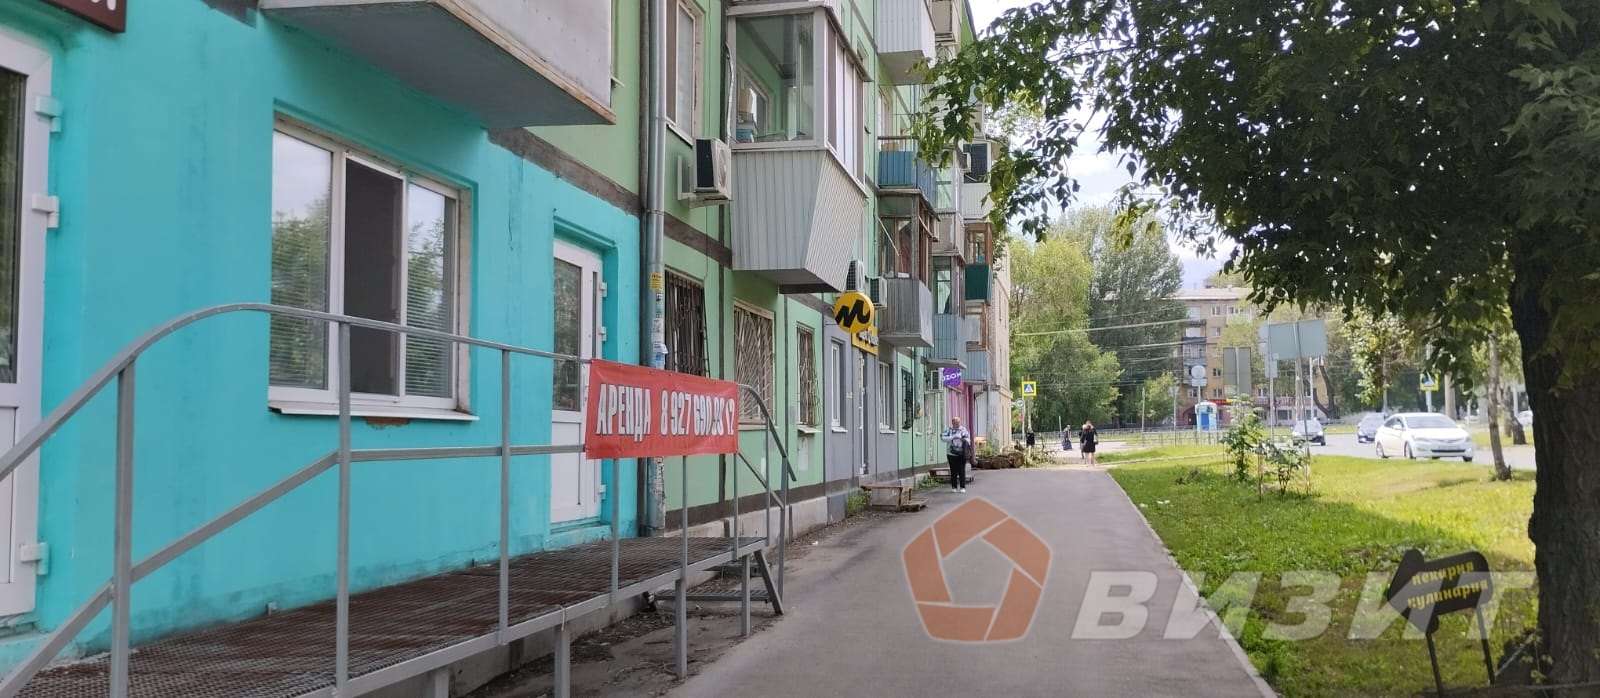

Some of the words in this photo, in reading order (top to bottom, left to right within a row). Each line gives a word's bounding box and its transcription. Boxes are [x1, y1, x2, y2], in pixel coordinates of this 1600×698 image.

[595, 384, 651, 442] АРЕНДА
[660, 390, 669, 435] 8
[671, 391, 692, 435] 927
[1407, 579, 1489, 610] кулинария
